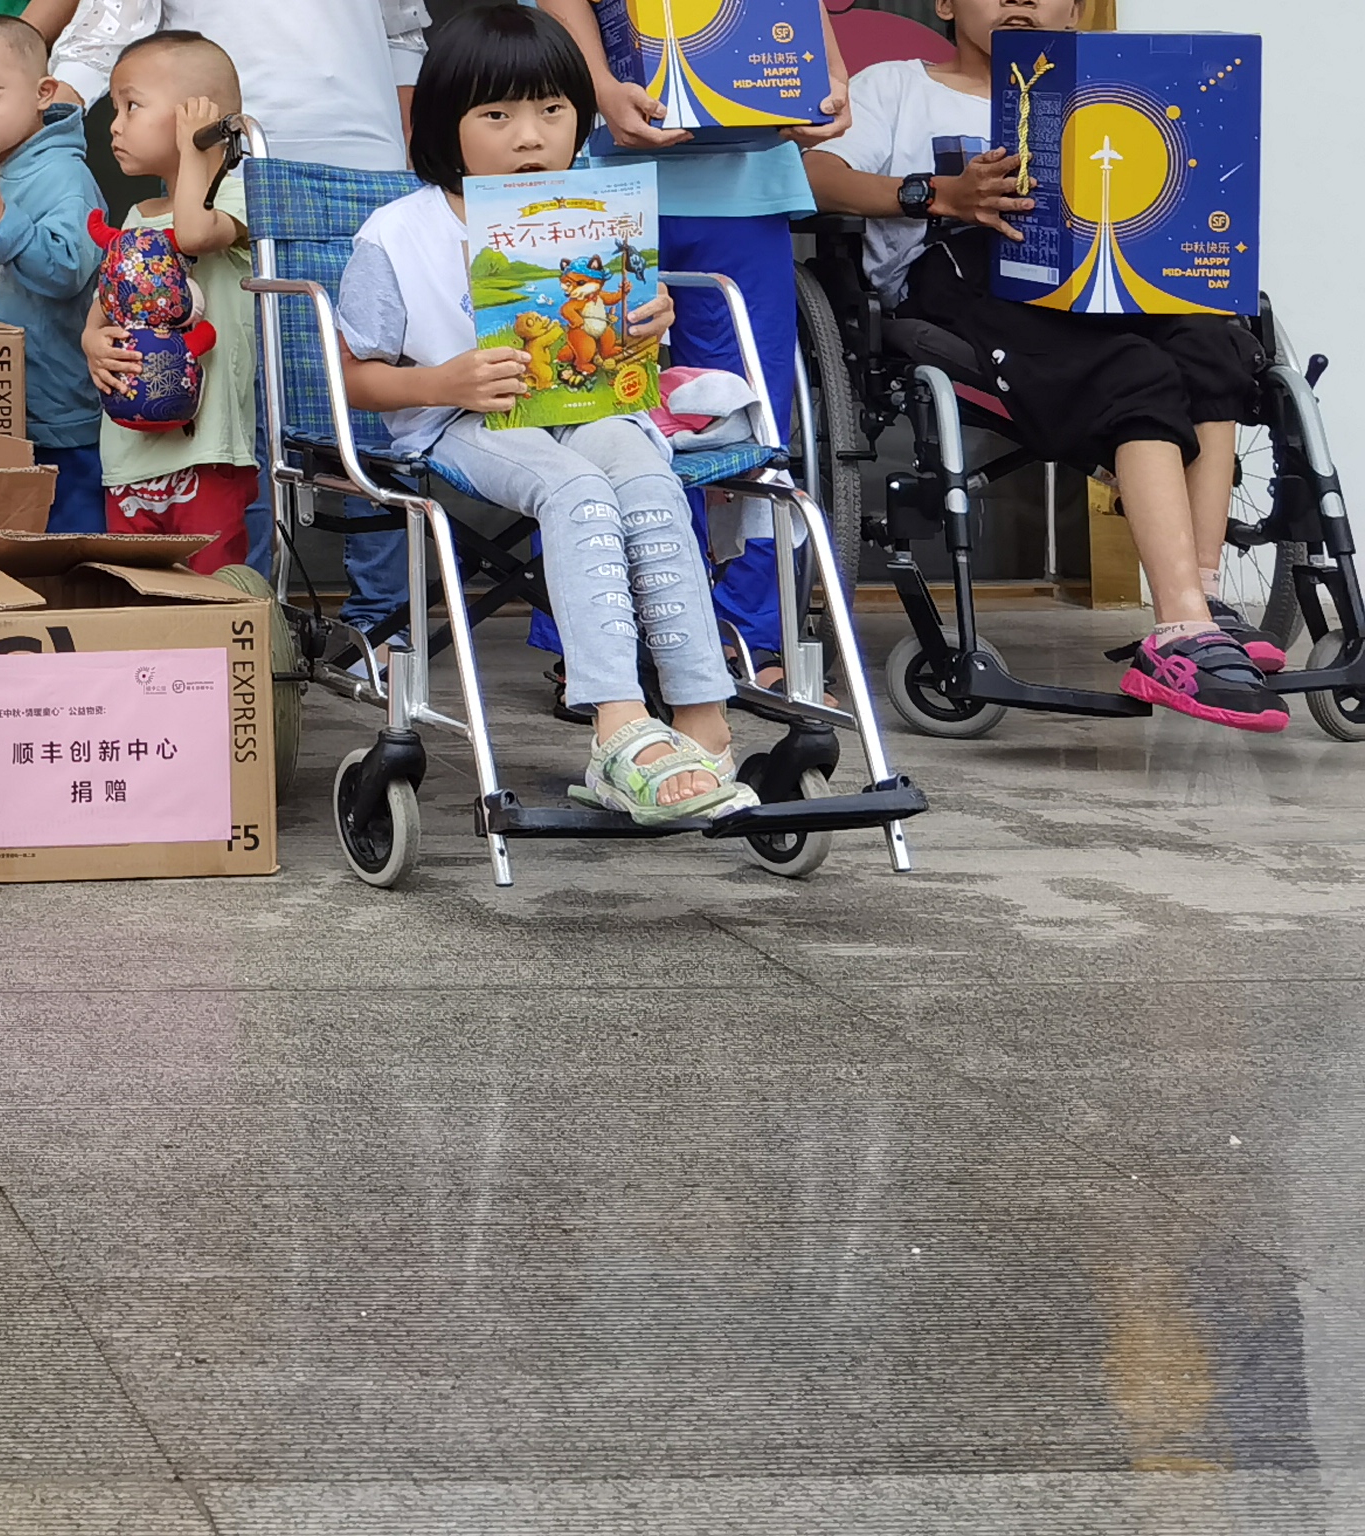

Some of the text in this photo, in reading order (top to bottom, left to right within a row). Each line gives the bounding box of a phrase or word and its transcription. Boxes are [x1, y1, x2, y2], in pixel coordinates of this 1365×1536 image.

[748, 52, 798, 65] 中秋快乐
[763, 66, 799, 77] HAPPY
[732, 77, 801, 89] MID-AUTUMN
[779, 88, 801, 98] DAY
[1180, 241, 1231, 255] 中秋快乐
[1194, 256, 1230, 267] HAPPY
[1162, 267, 1231, 278] MID-AUTUMN
[1208, 279, 1230, 289] DAY
[231, 619, 257, 763] SF EXPRESS
[12, 738, 179, 765] 顺丰创新中心
[71, 779, 127, 804] 捐赠
[226, 824, 261, 852] F5
